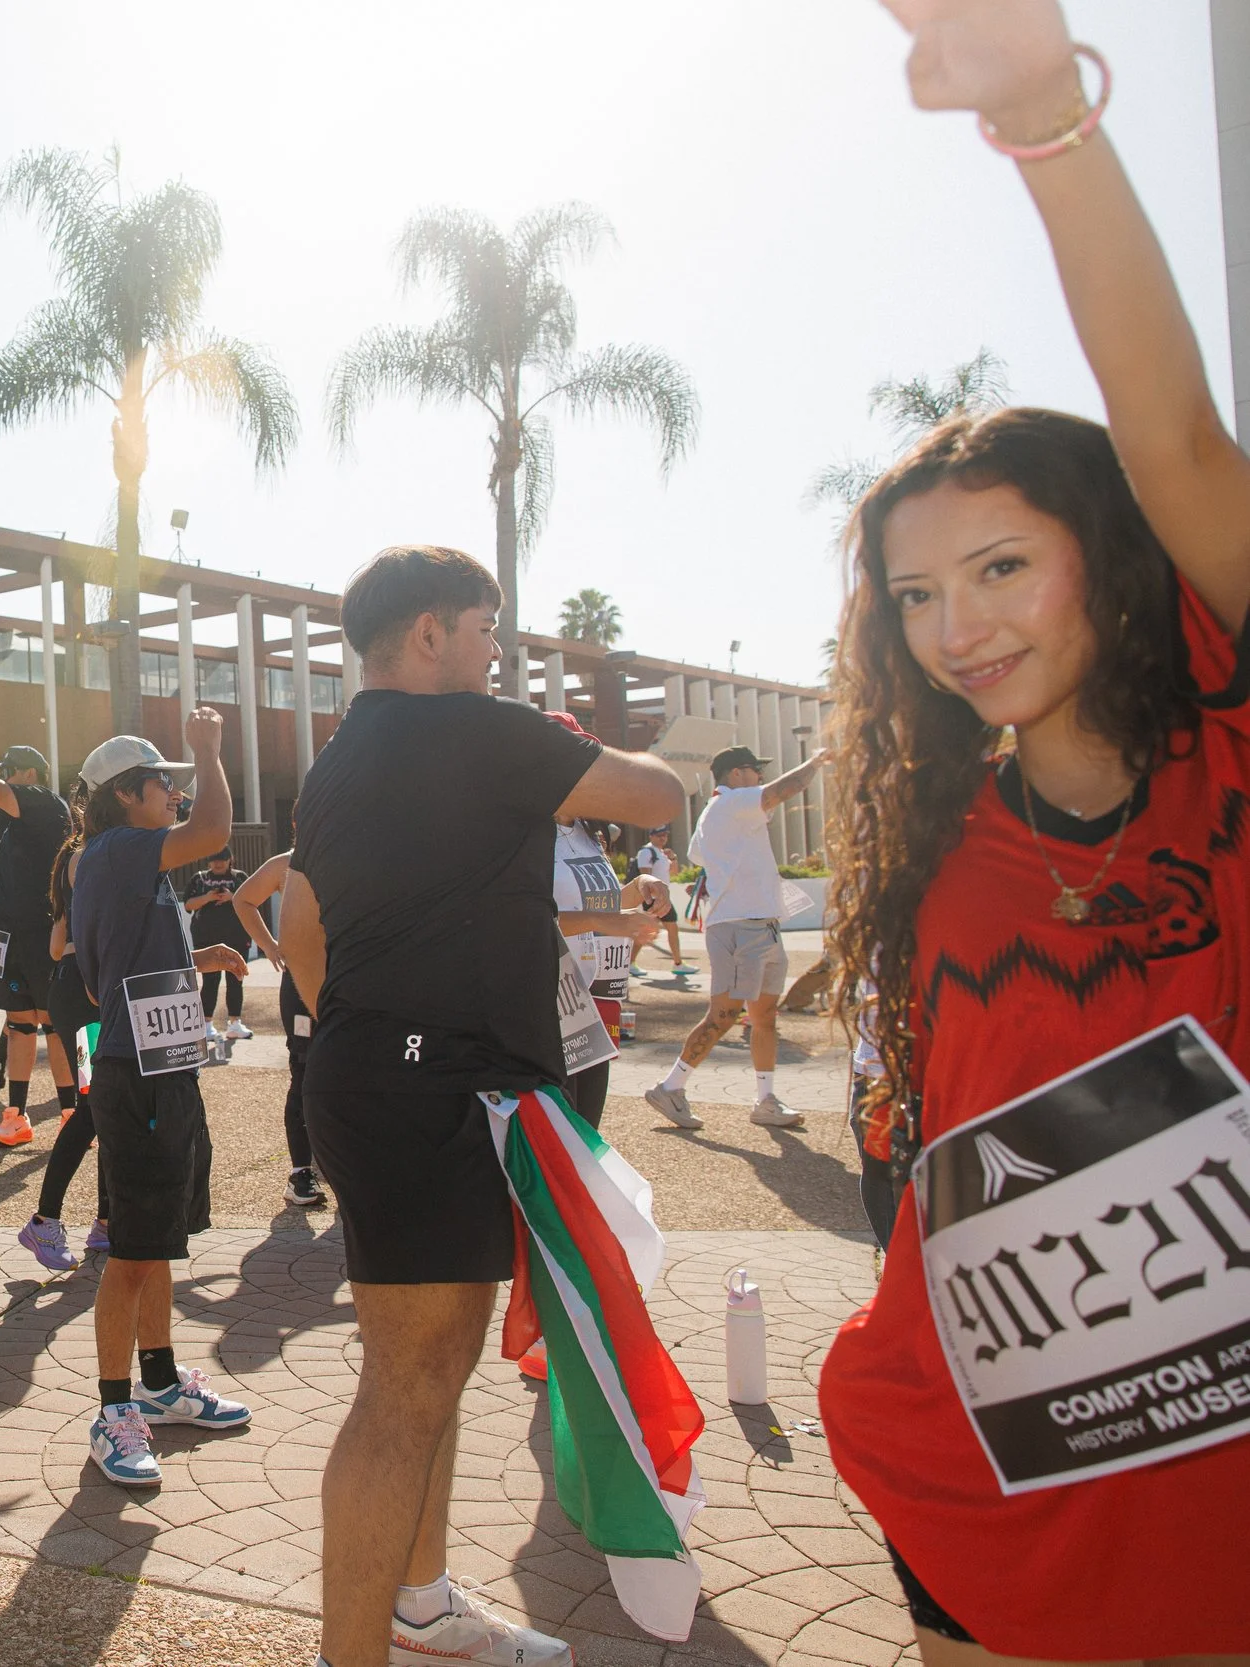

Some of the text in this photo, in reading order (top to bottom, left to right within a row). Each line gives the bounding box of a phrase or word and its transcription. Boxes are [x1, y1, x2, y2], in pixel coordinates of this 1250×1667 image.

[1050, 1340, 1250, 1427] COMPTON AR
[1065, 1416, 1146, 1453] HISTORY
